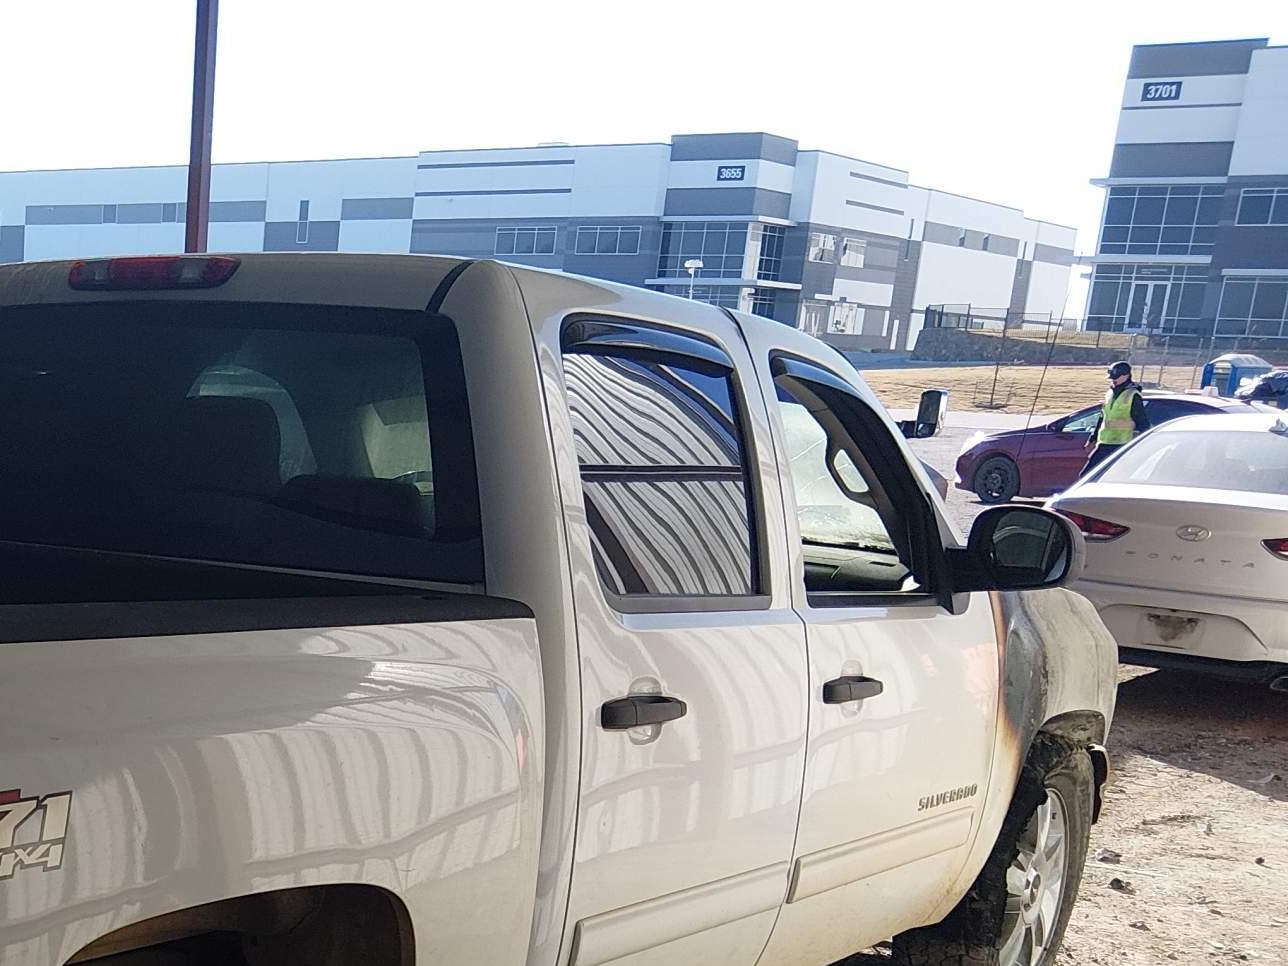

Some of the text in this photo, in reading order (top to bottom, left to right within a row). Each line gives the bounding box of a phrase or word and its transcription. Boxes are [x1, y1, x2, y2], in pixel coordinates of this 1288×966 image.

[1146, 85, 1178, 99] 3701
[719, 168, 743, 179] 3655
[917, 783, 978, 812] SILVERADO
